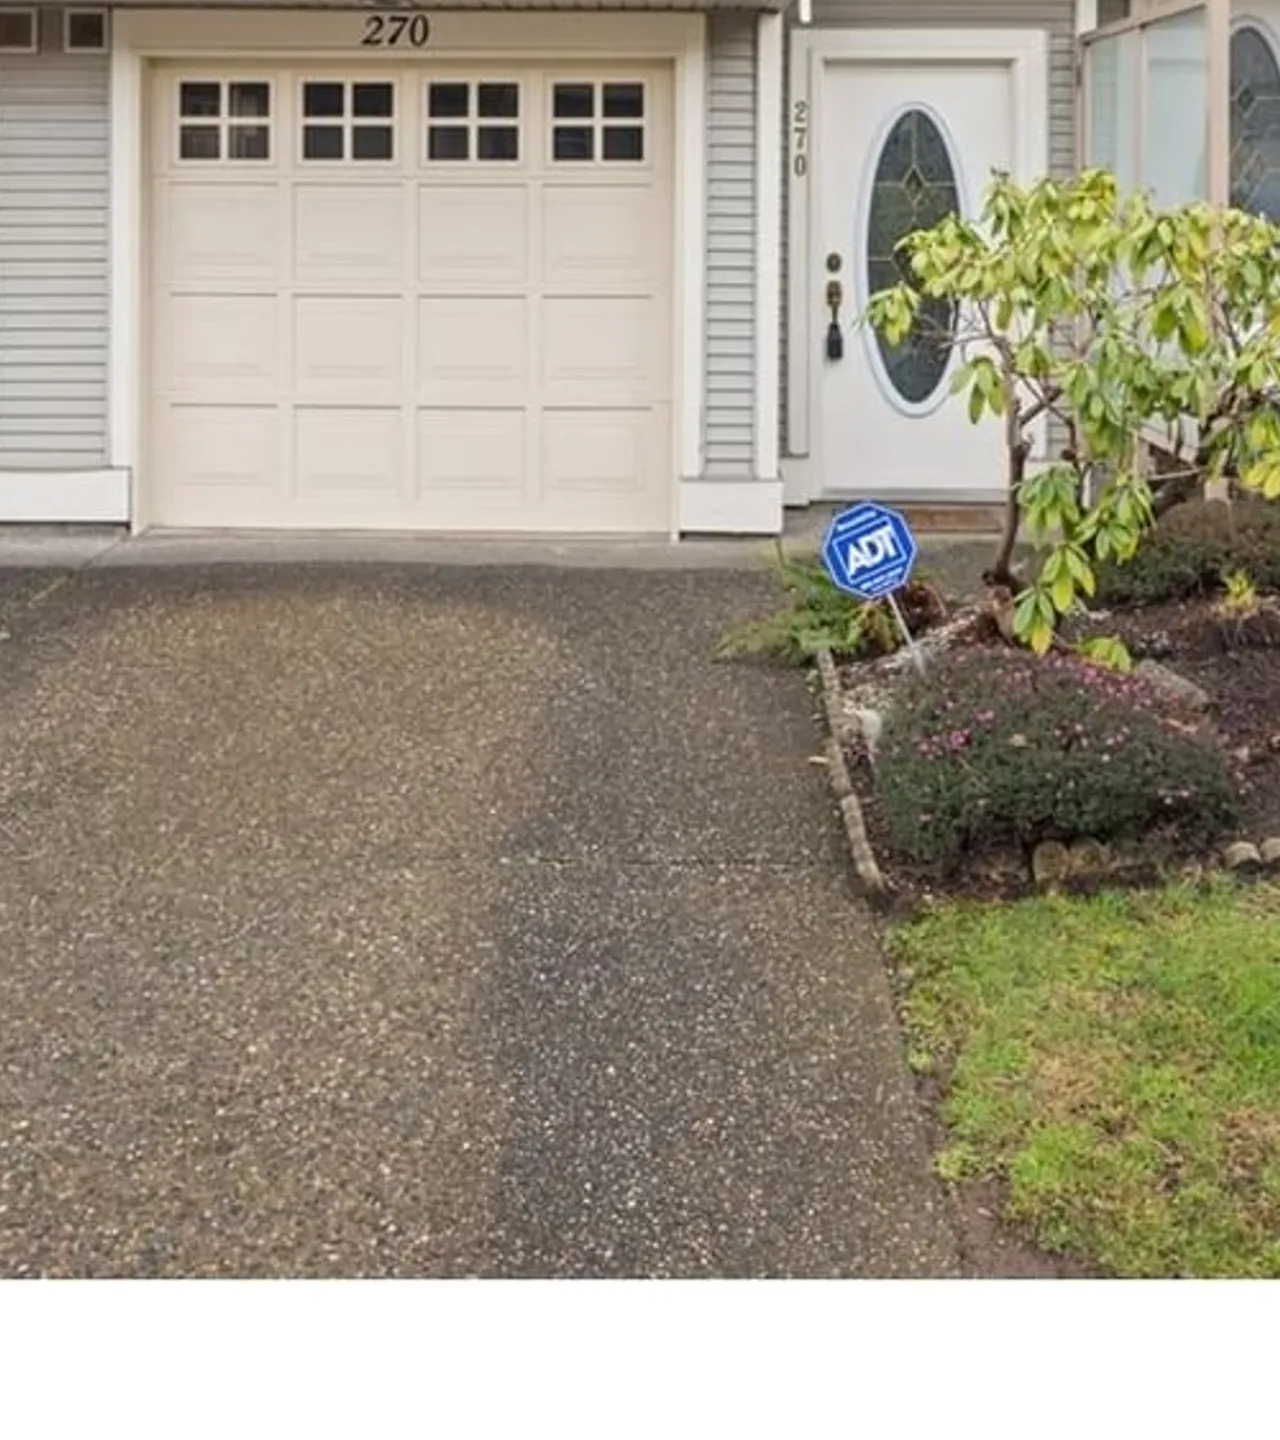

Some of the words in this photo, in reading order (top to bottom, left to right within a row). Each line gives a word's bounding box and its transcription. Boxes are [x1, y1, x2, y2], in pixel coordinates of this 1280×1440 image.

[361, 14, 429, 47] 270
[793, 100, 808, 178] 270
[848, 525, 898, 577] ADT
